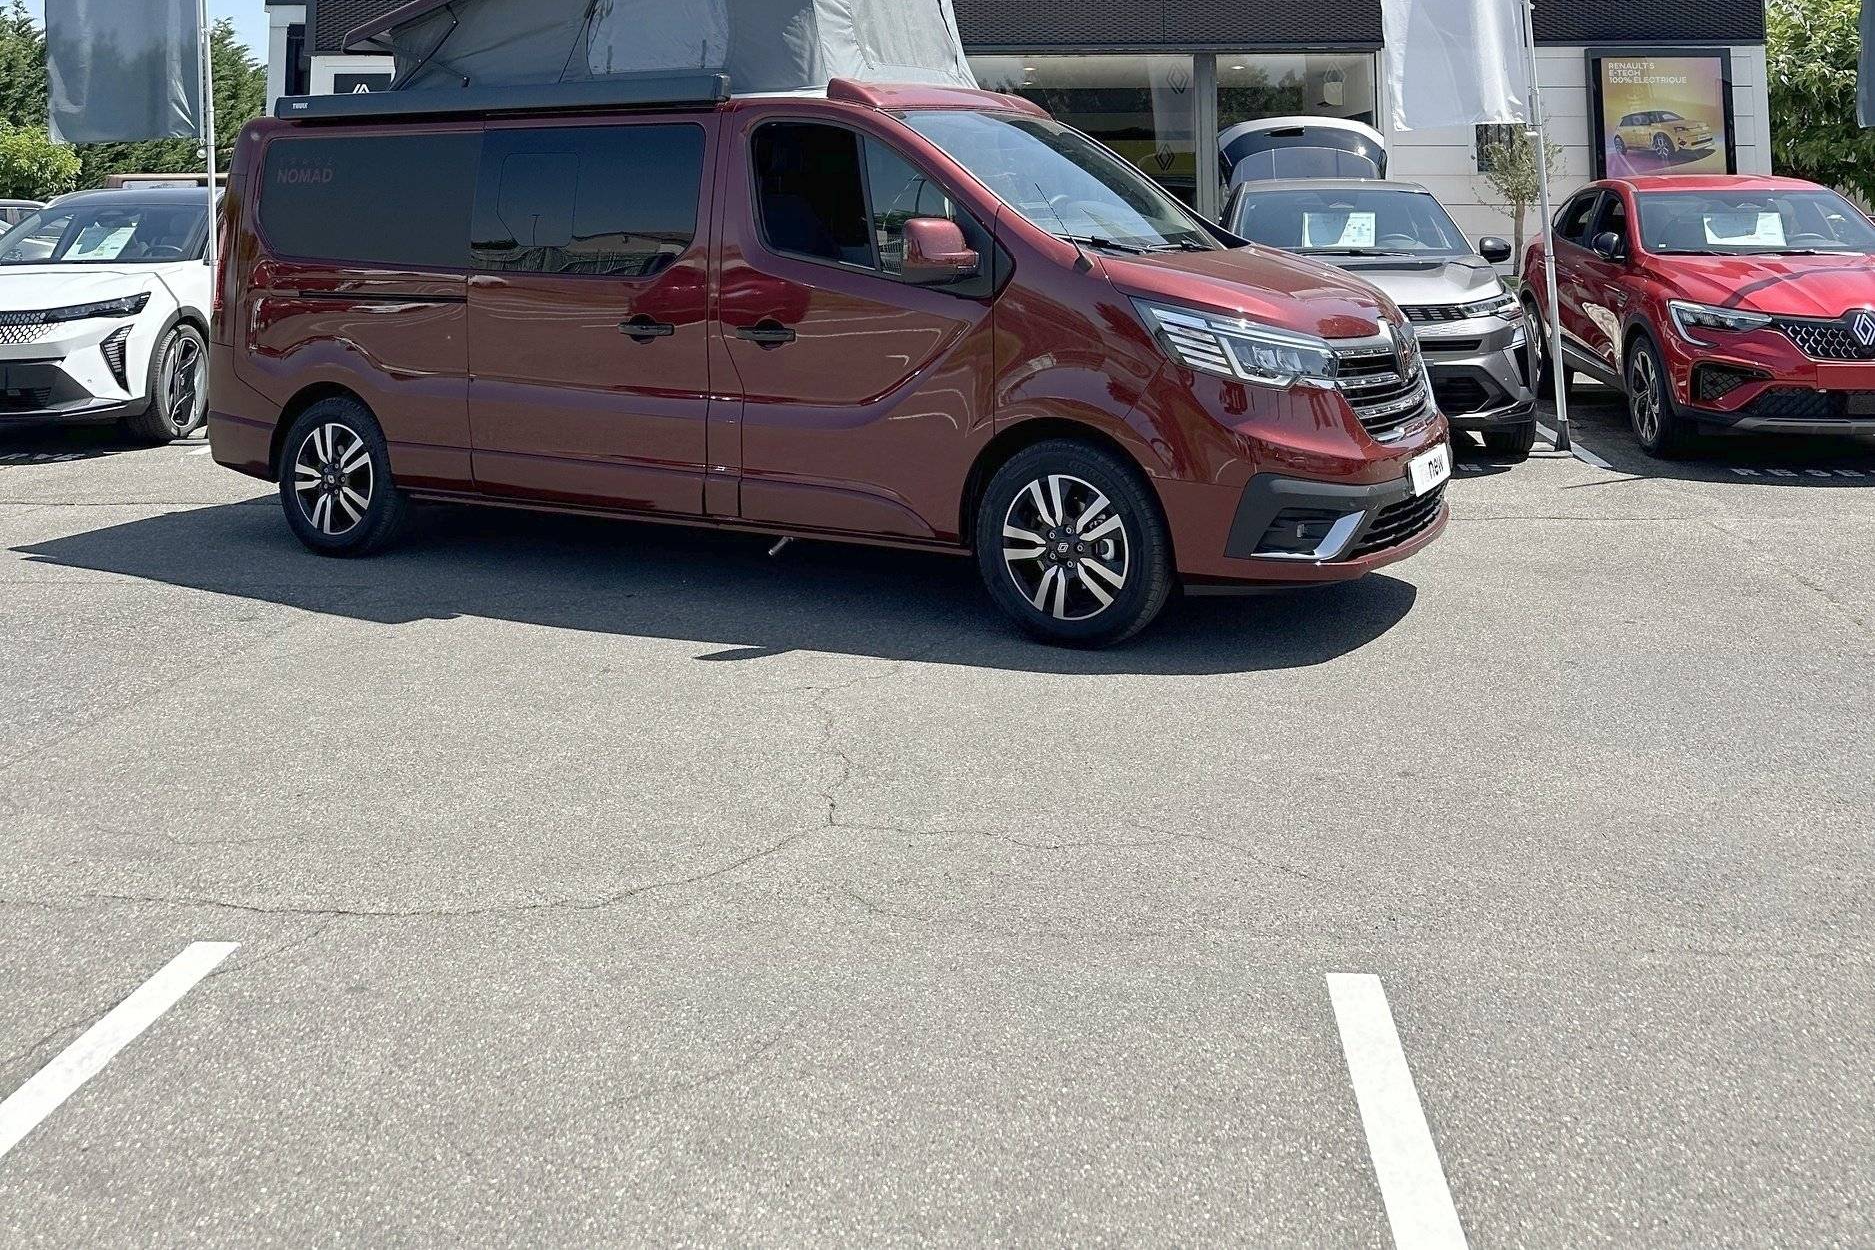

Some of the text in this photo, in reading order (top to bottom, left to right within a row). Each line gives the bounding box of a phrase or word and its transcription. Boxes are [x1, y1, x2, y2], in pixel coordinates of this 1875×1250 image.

[1608, 62, 1648, 70] RENAULT
[1608, 76, 1632, 84] 100%
[276, 168, 334, 184] NOMAD
